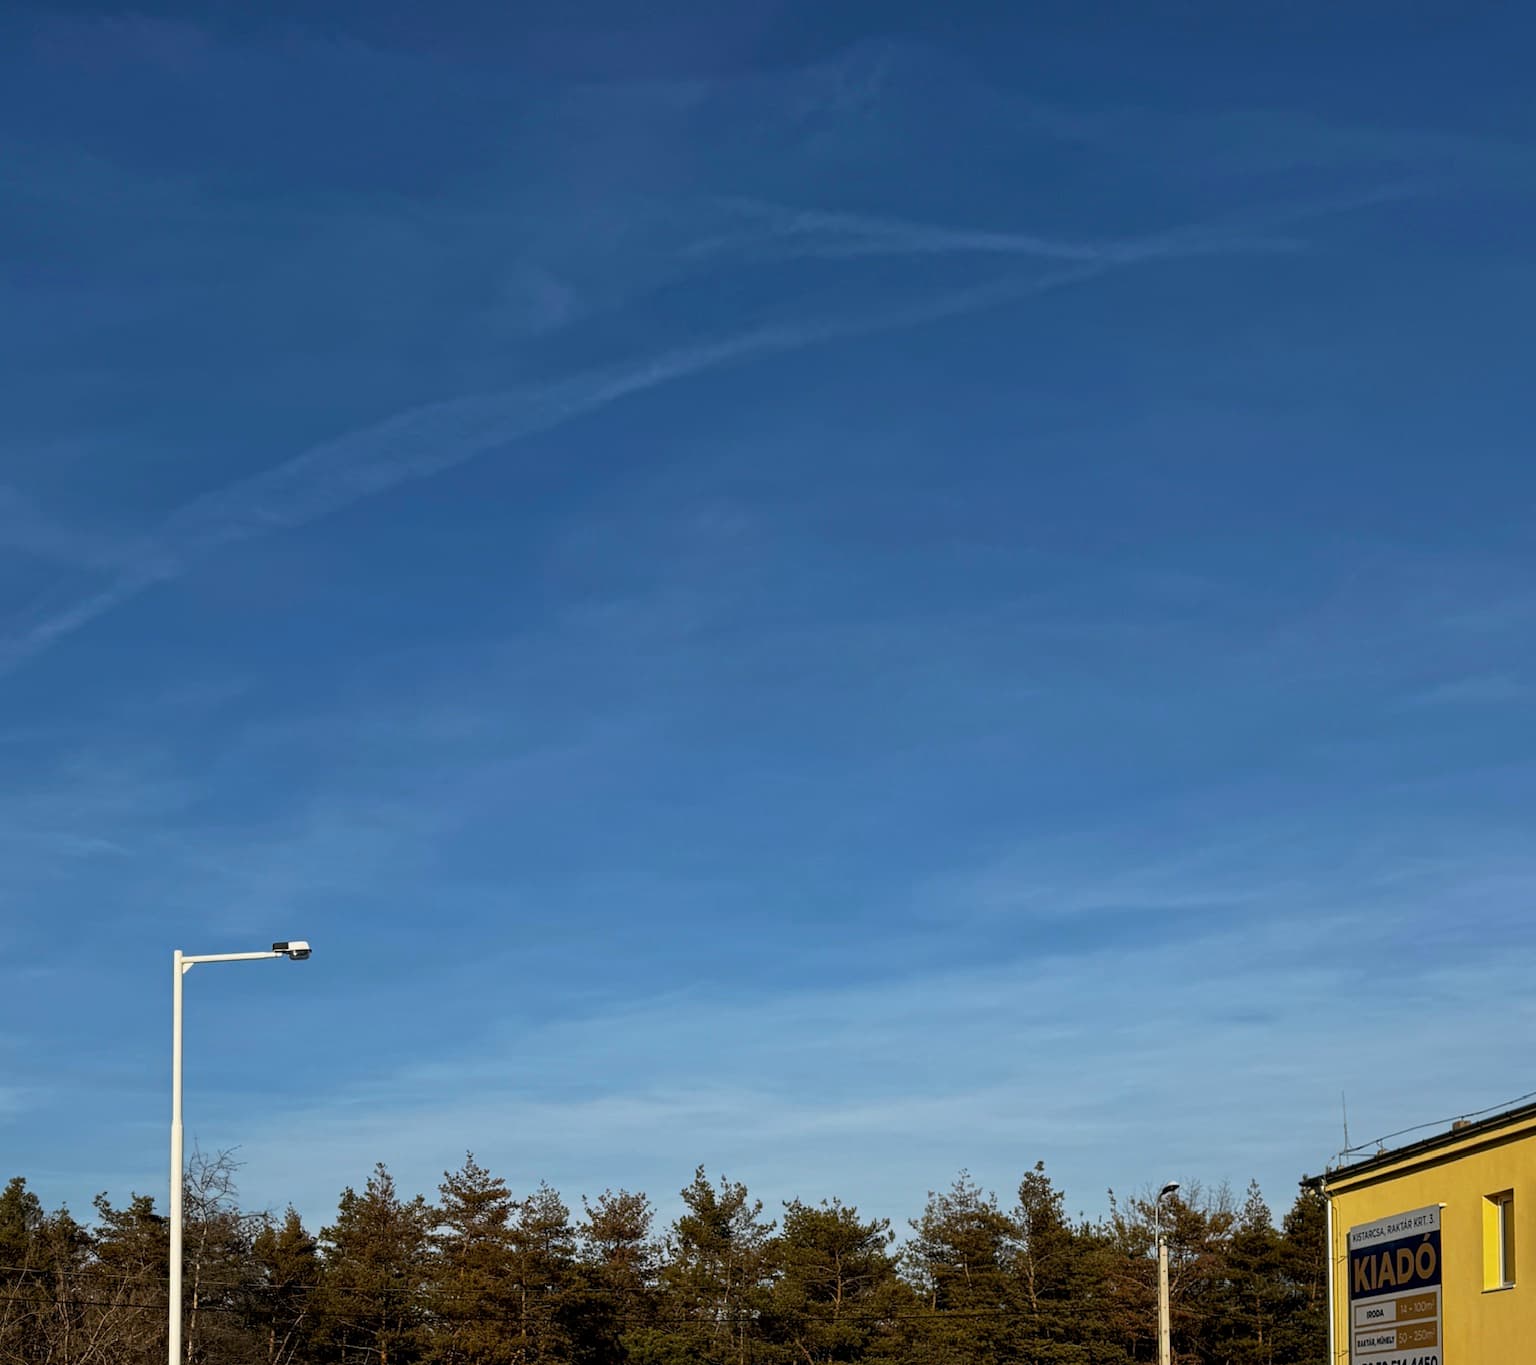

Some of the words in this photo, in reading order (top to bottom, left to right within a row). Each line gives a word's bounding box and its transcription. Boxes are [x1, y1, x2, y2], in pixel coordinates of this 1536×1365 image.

[1387, 1217, 1412, 1234] RAKTÁR
[1413, 1215, 1428, 1228] KRT.
[1354, 1233, 1436, 1293] KIADÓ
[1366, 1309, 1384, 1319] IRODA
[1399, 1332, 1407, 1344] 50
